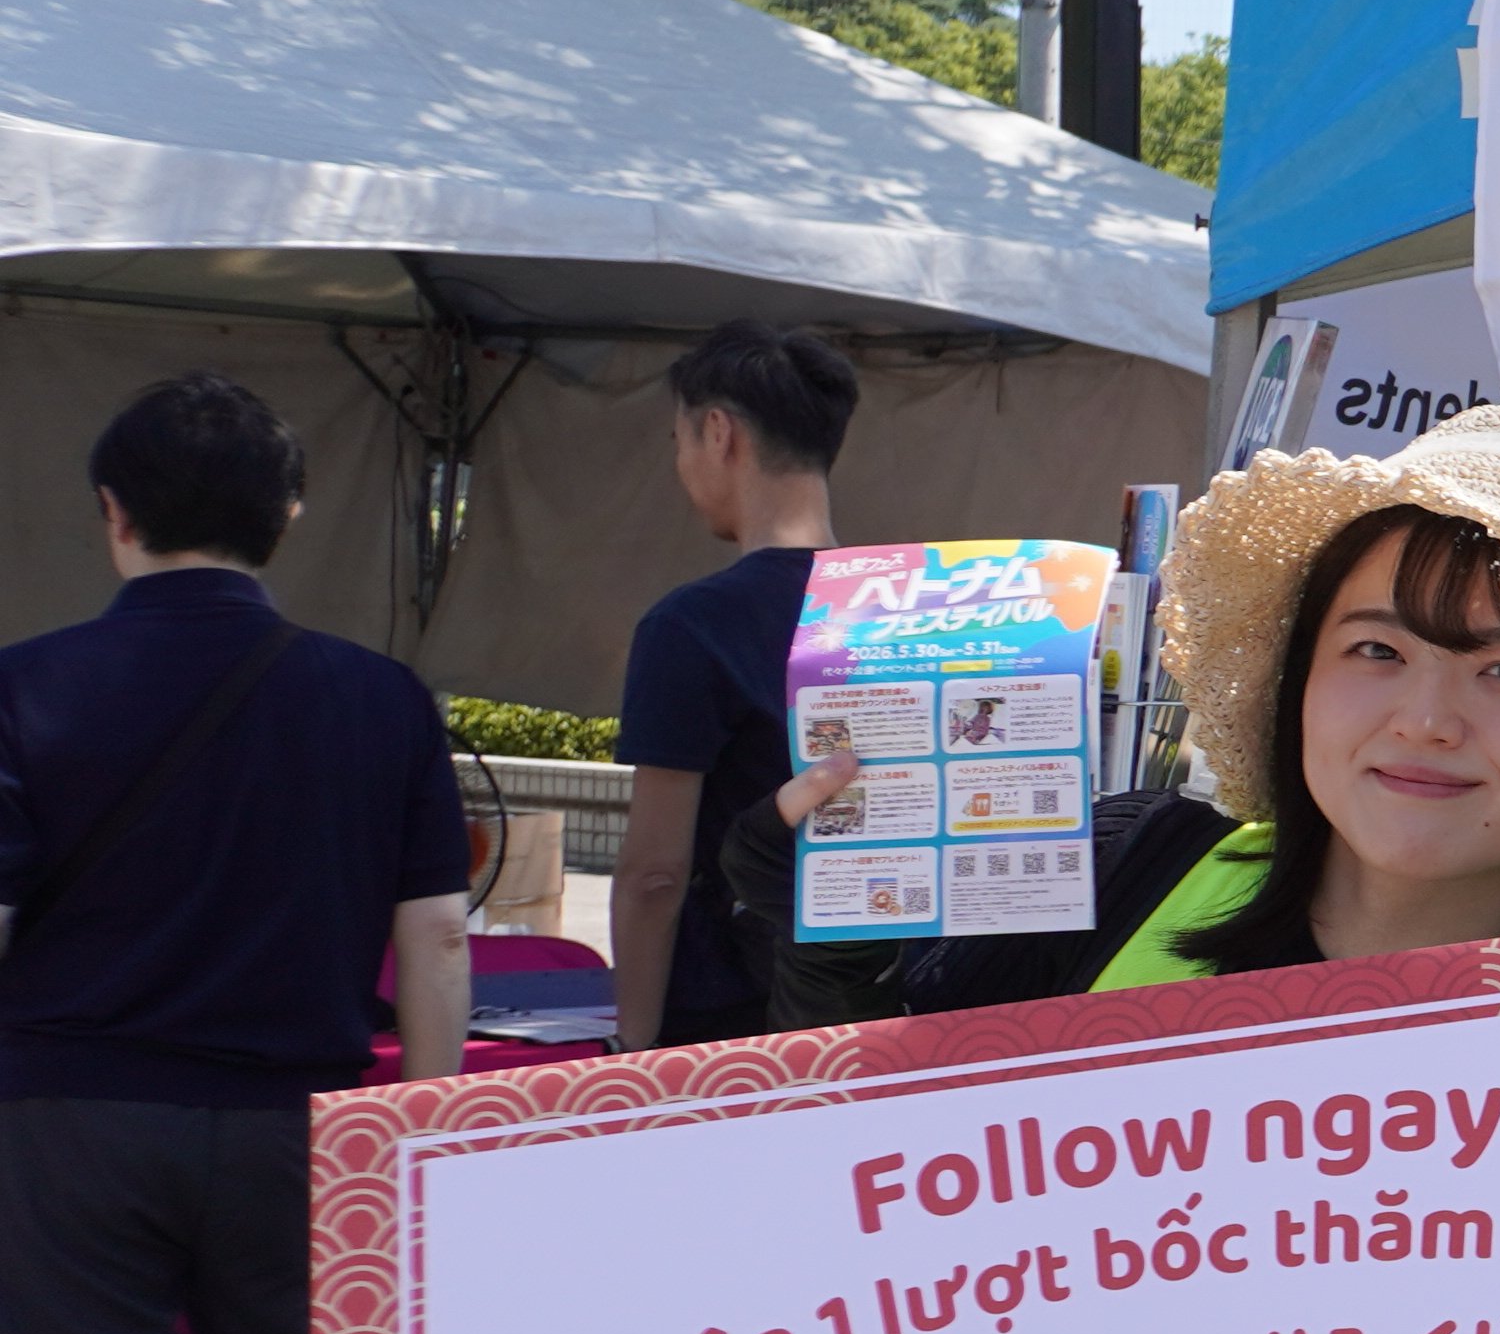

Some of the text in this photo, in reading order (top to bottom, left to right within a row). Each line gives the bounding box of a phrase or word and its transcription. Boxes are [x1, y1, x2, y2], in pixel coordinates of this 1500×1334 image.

[847, 557, 1041, 611] ベトナム
[871, 597, 1054, 639] フェスティバル
[852, 1108, 1212, 1234] Follow
[875, 1243, 1071, 1333] lượt
[1093, 1193, 1248, 1292] bốc
[1274, 1189, 1494, 1267] thăm
